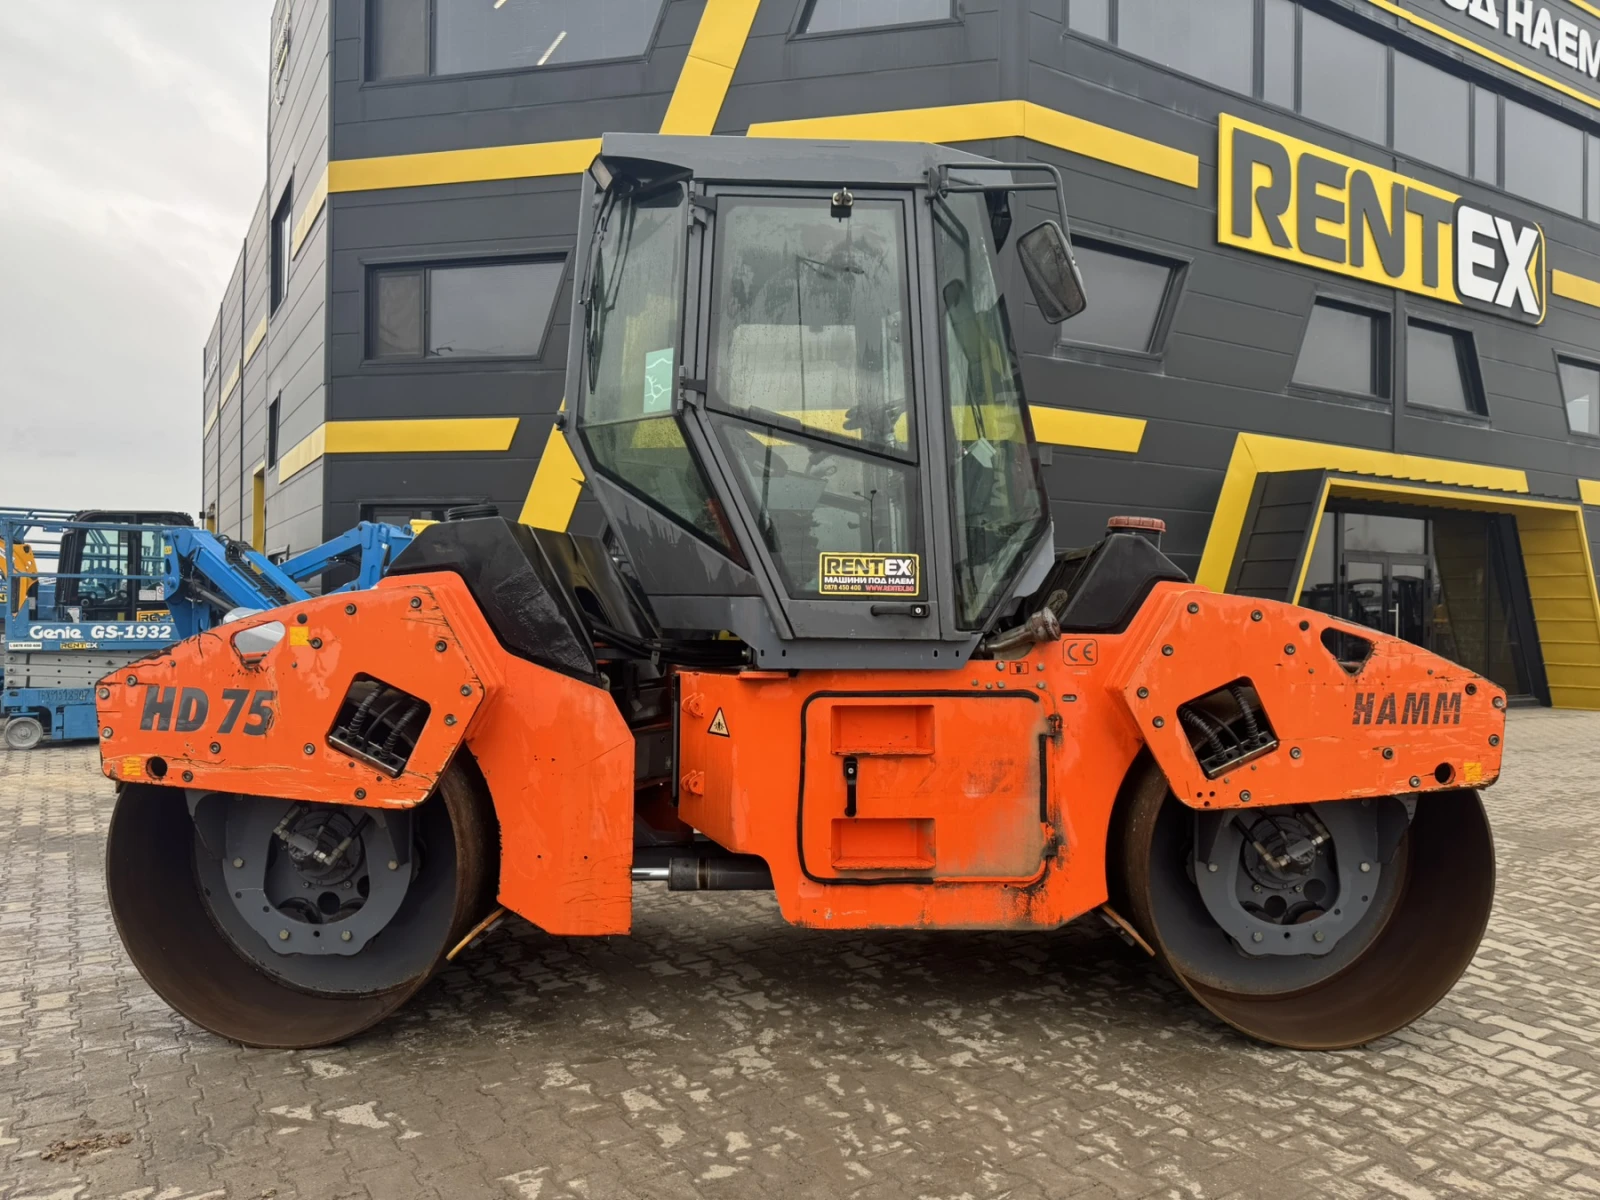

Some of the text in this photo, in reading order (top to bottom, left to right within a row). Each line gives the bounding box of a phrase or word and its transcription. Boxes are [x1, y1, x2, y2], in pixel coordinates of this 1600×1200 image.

[1232, 127, 1541, 316] RENTEX
[826, 558, 912, 576] RENTEX
[824, 576, 866, 584] МАШИНИ
[888, 577, 914, 585] НАЕМ
[29, 625, 172, 640] Genie GS-1932
[1067, 643, 1094, 662] CE
[140, 685, 275, 736] HD 75
[1352, 692, 1462, 725] HAMM
